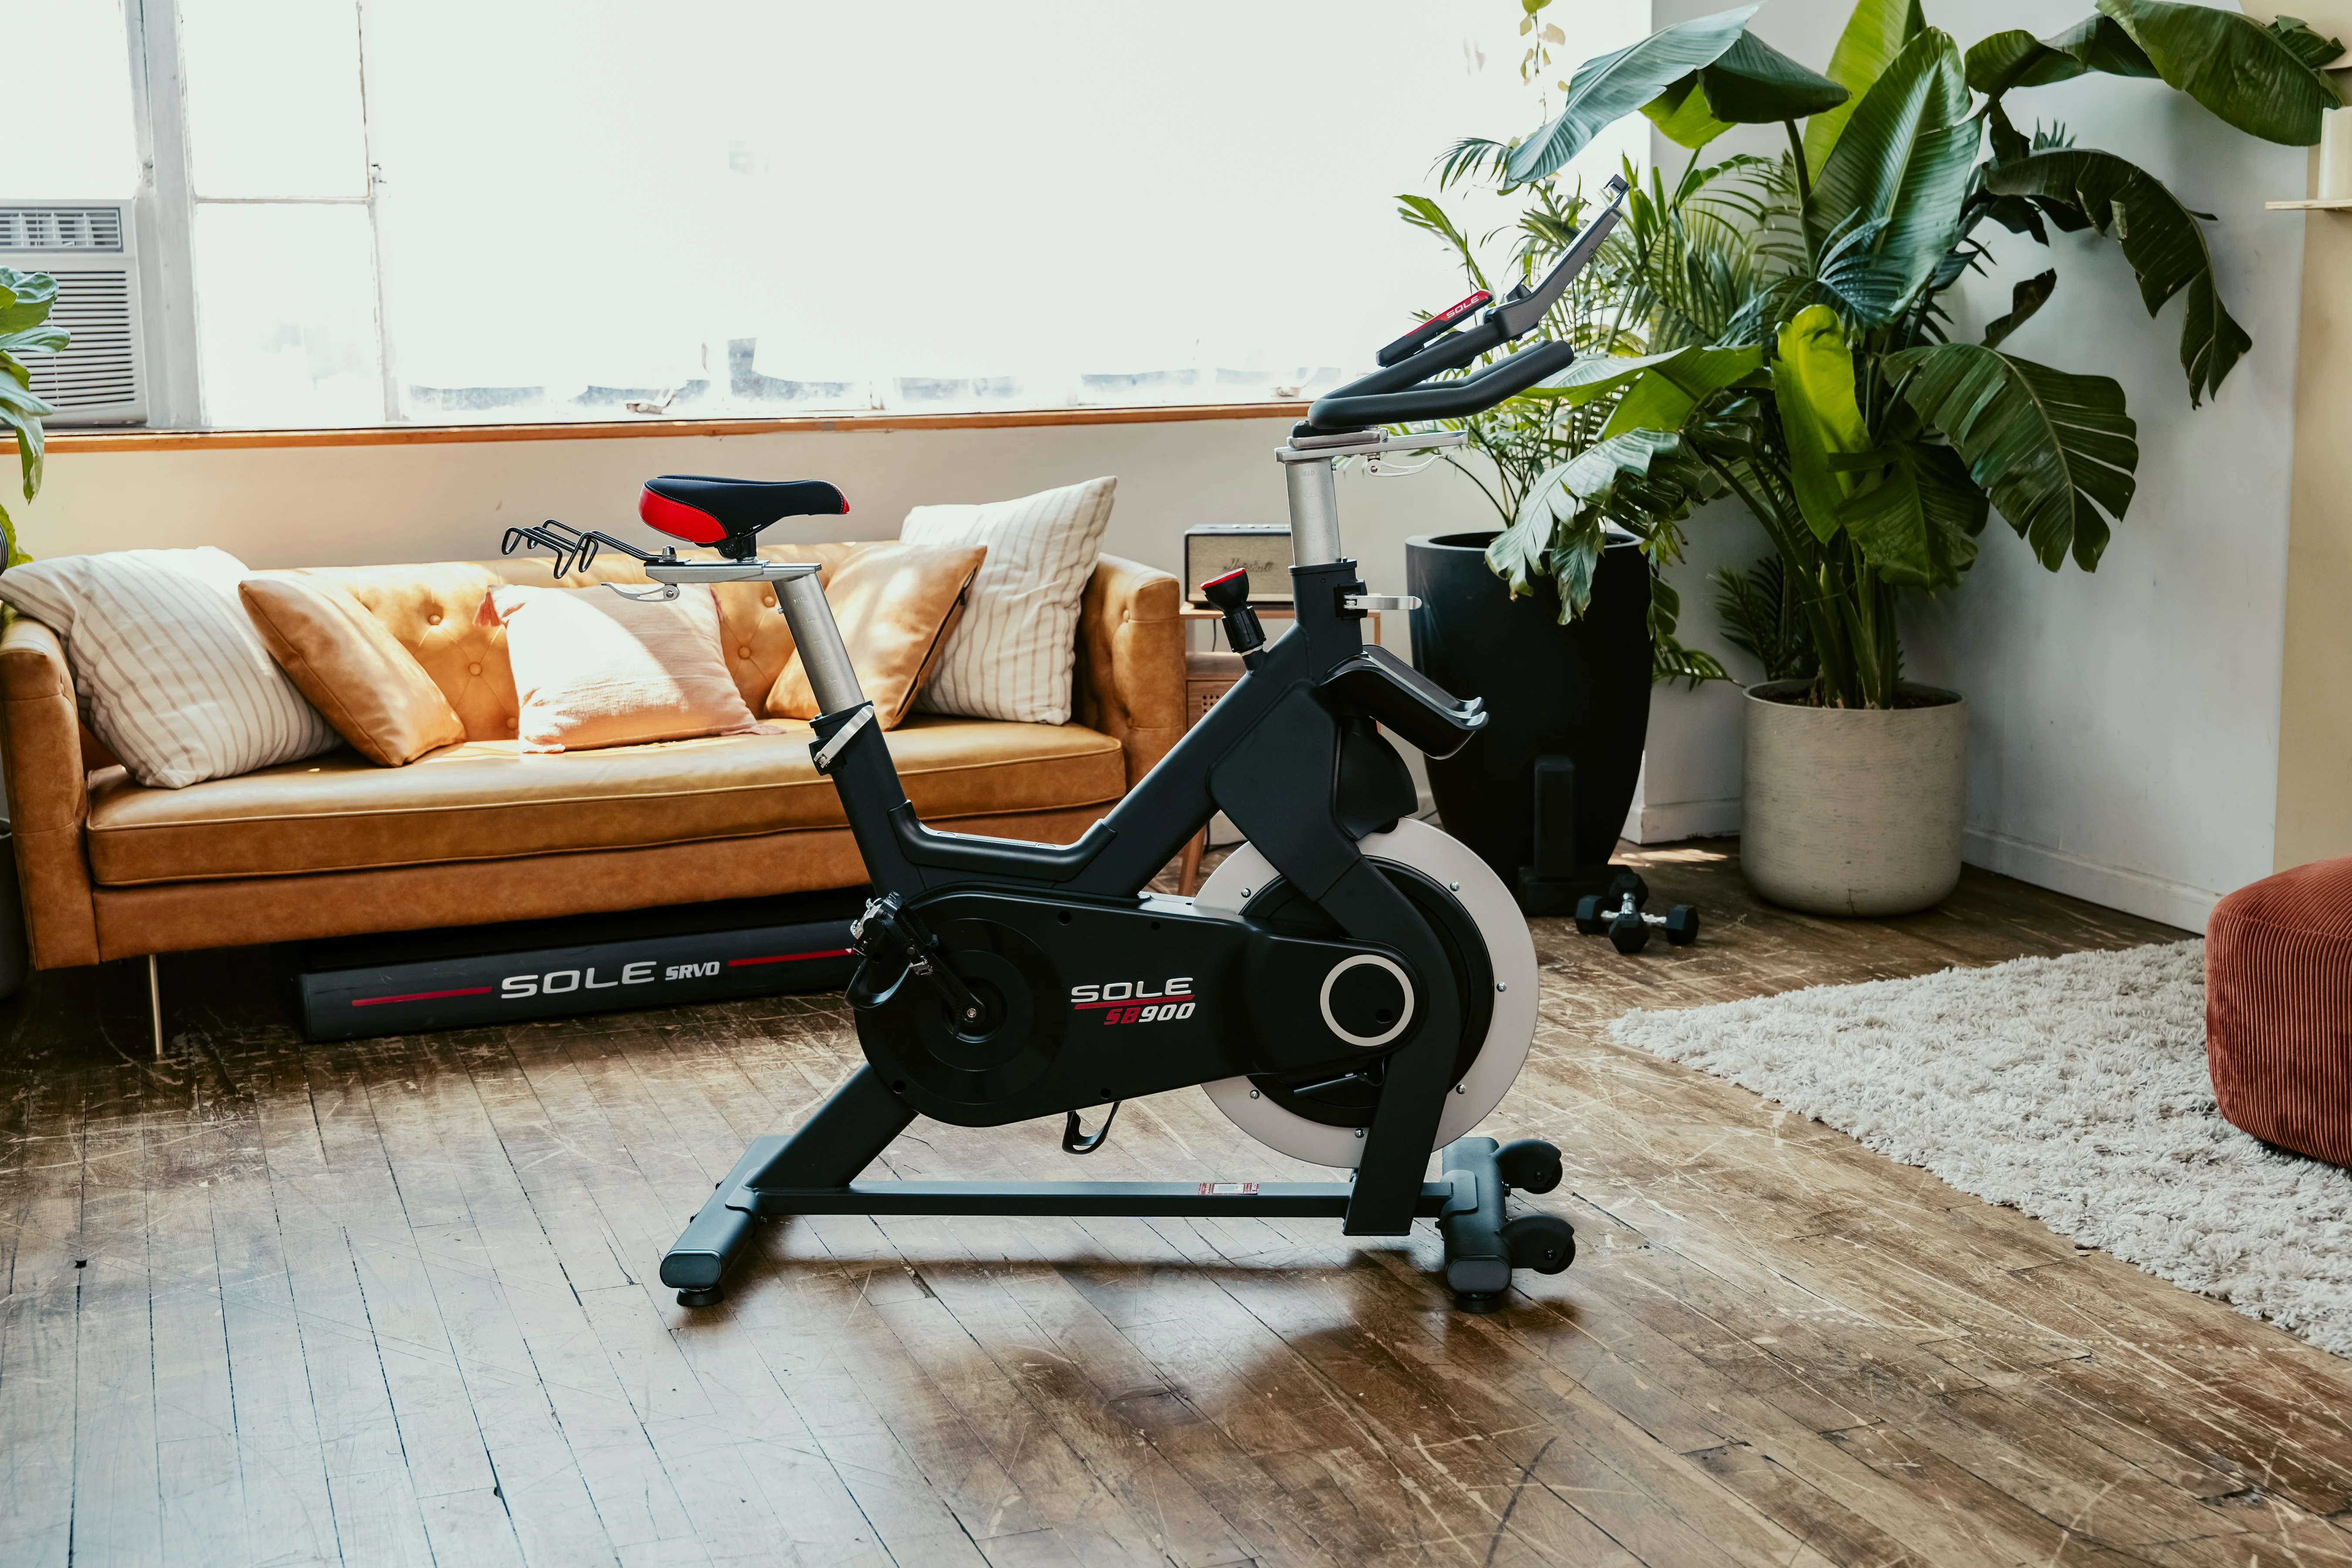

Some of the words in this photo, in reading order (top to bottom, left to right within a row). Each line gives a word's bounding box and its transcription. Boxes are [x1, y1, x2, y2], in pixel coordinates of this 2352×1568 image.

[1446, 295, 1479, 318] SOLE
[793, 595, 806, 605] MIN
[501, 961, 657, 999] SOLE
[665, 961, 720, 981] SRVO
[1071, 977, 1193, 1003] SOLE
[1104, 1002, 1196, 1025] SB900
